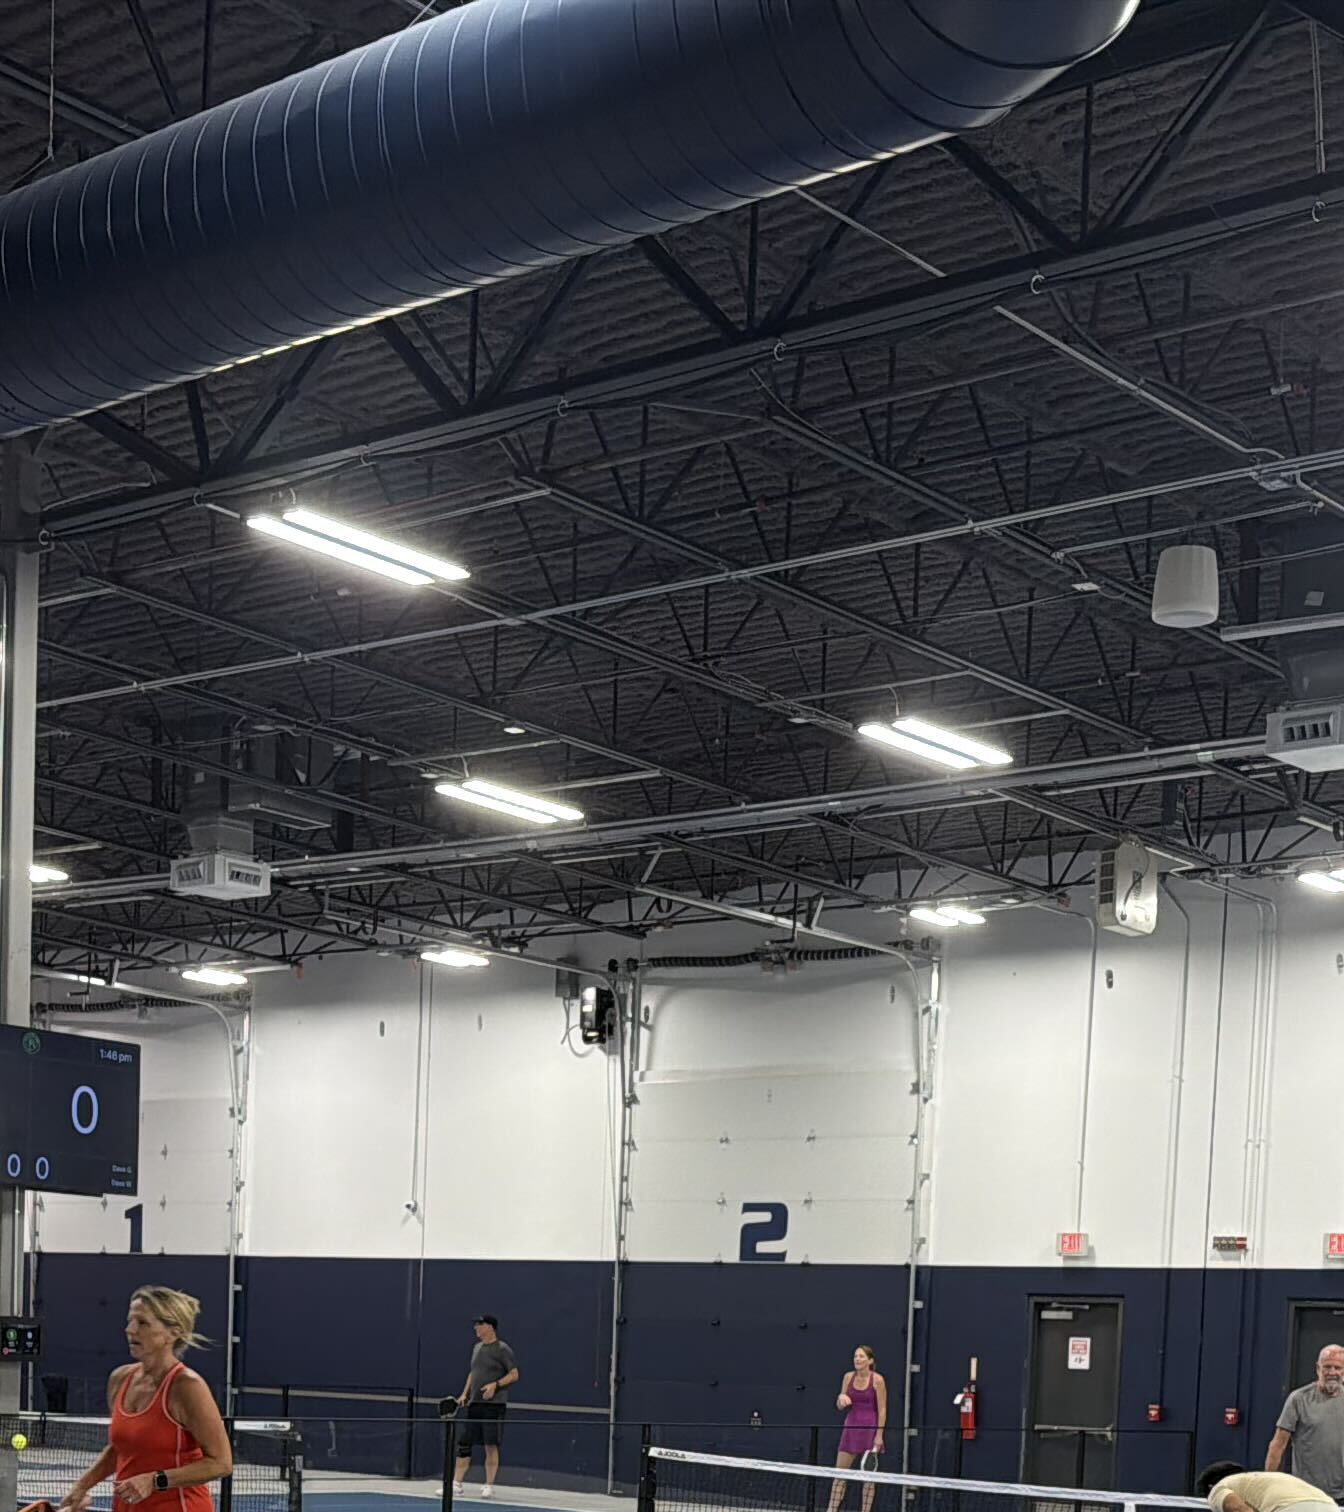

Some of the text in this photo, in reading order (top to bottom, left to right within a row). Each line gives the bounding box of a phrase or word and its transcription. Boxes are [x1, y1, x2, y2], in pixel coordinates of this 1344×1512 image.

[118, 1054, 132, 1063] pm
[71, 1085, 99, 1135] 0
[7, 1153, 21, 1178] 0
[36, 1156, 49, 1180] 0
[125, 1204, 143, 1254] 1
[739, 1203, 788, 1262] 2
